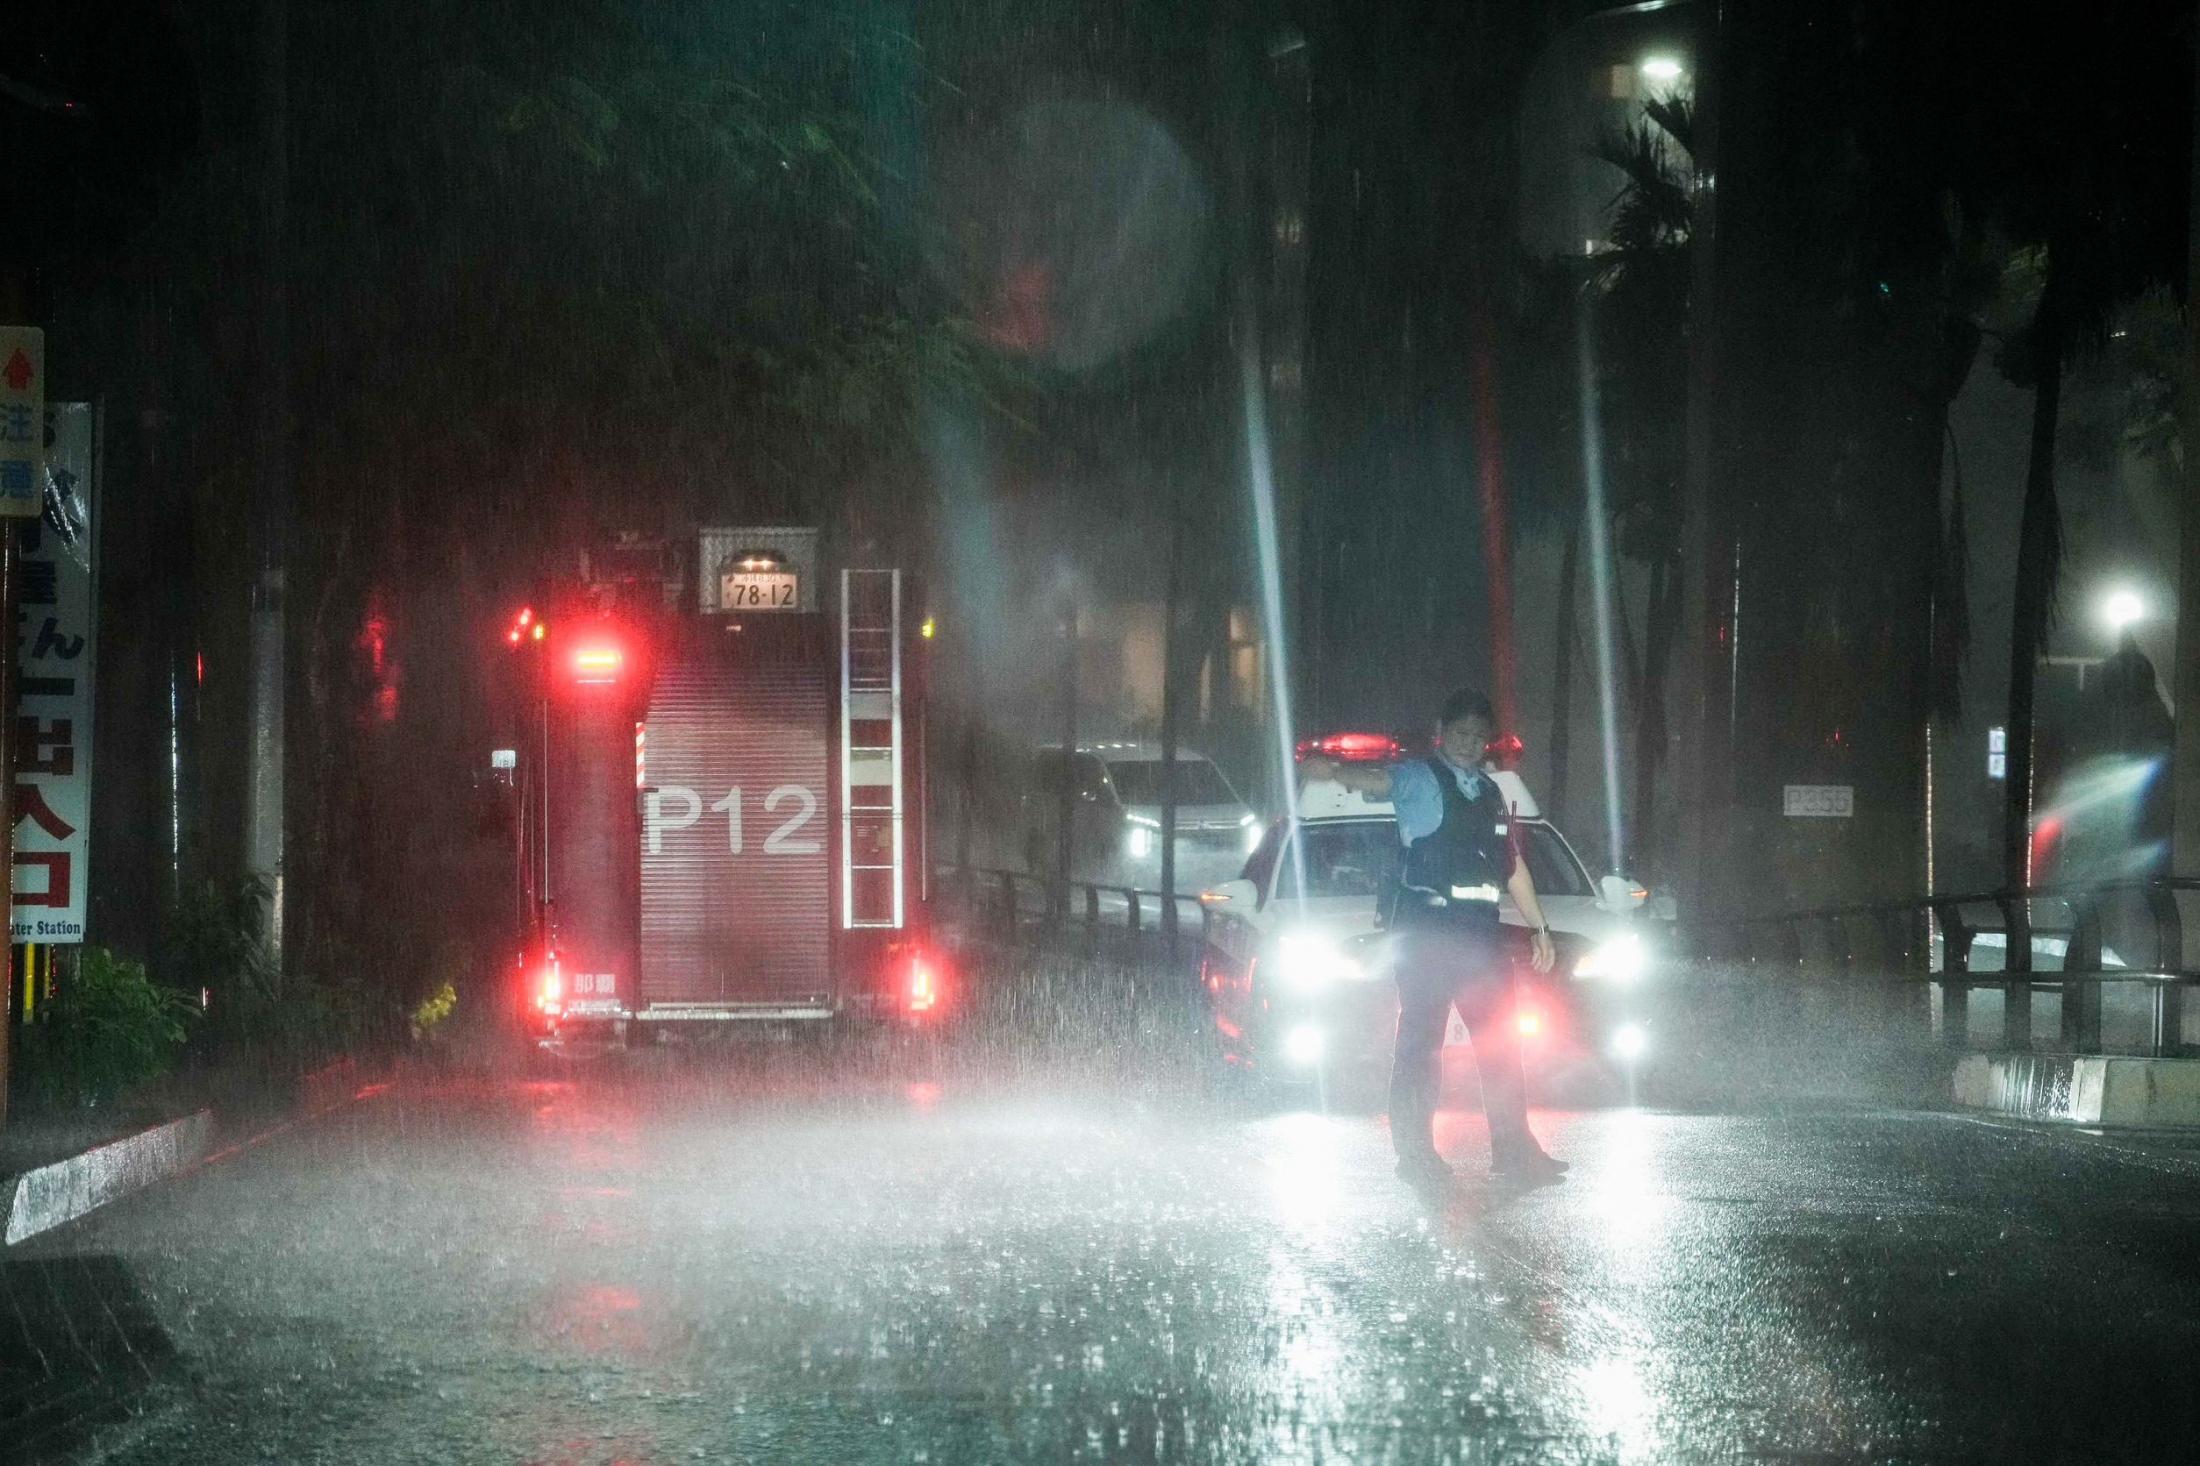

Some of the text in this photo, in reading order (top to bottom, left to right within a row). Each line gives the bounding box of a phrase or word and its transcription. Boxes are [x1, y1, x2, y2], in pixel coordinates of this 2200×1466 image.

[734, 584, 794, 606] 78-12
[648, 784, 821, 855] P12
[37, 921, 81, 935] Station
